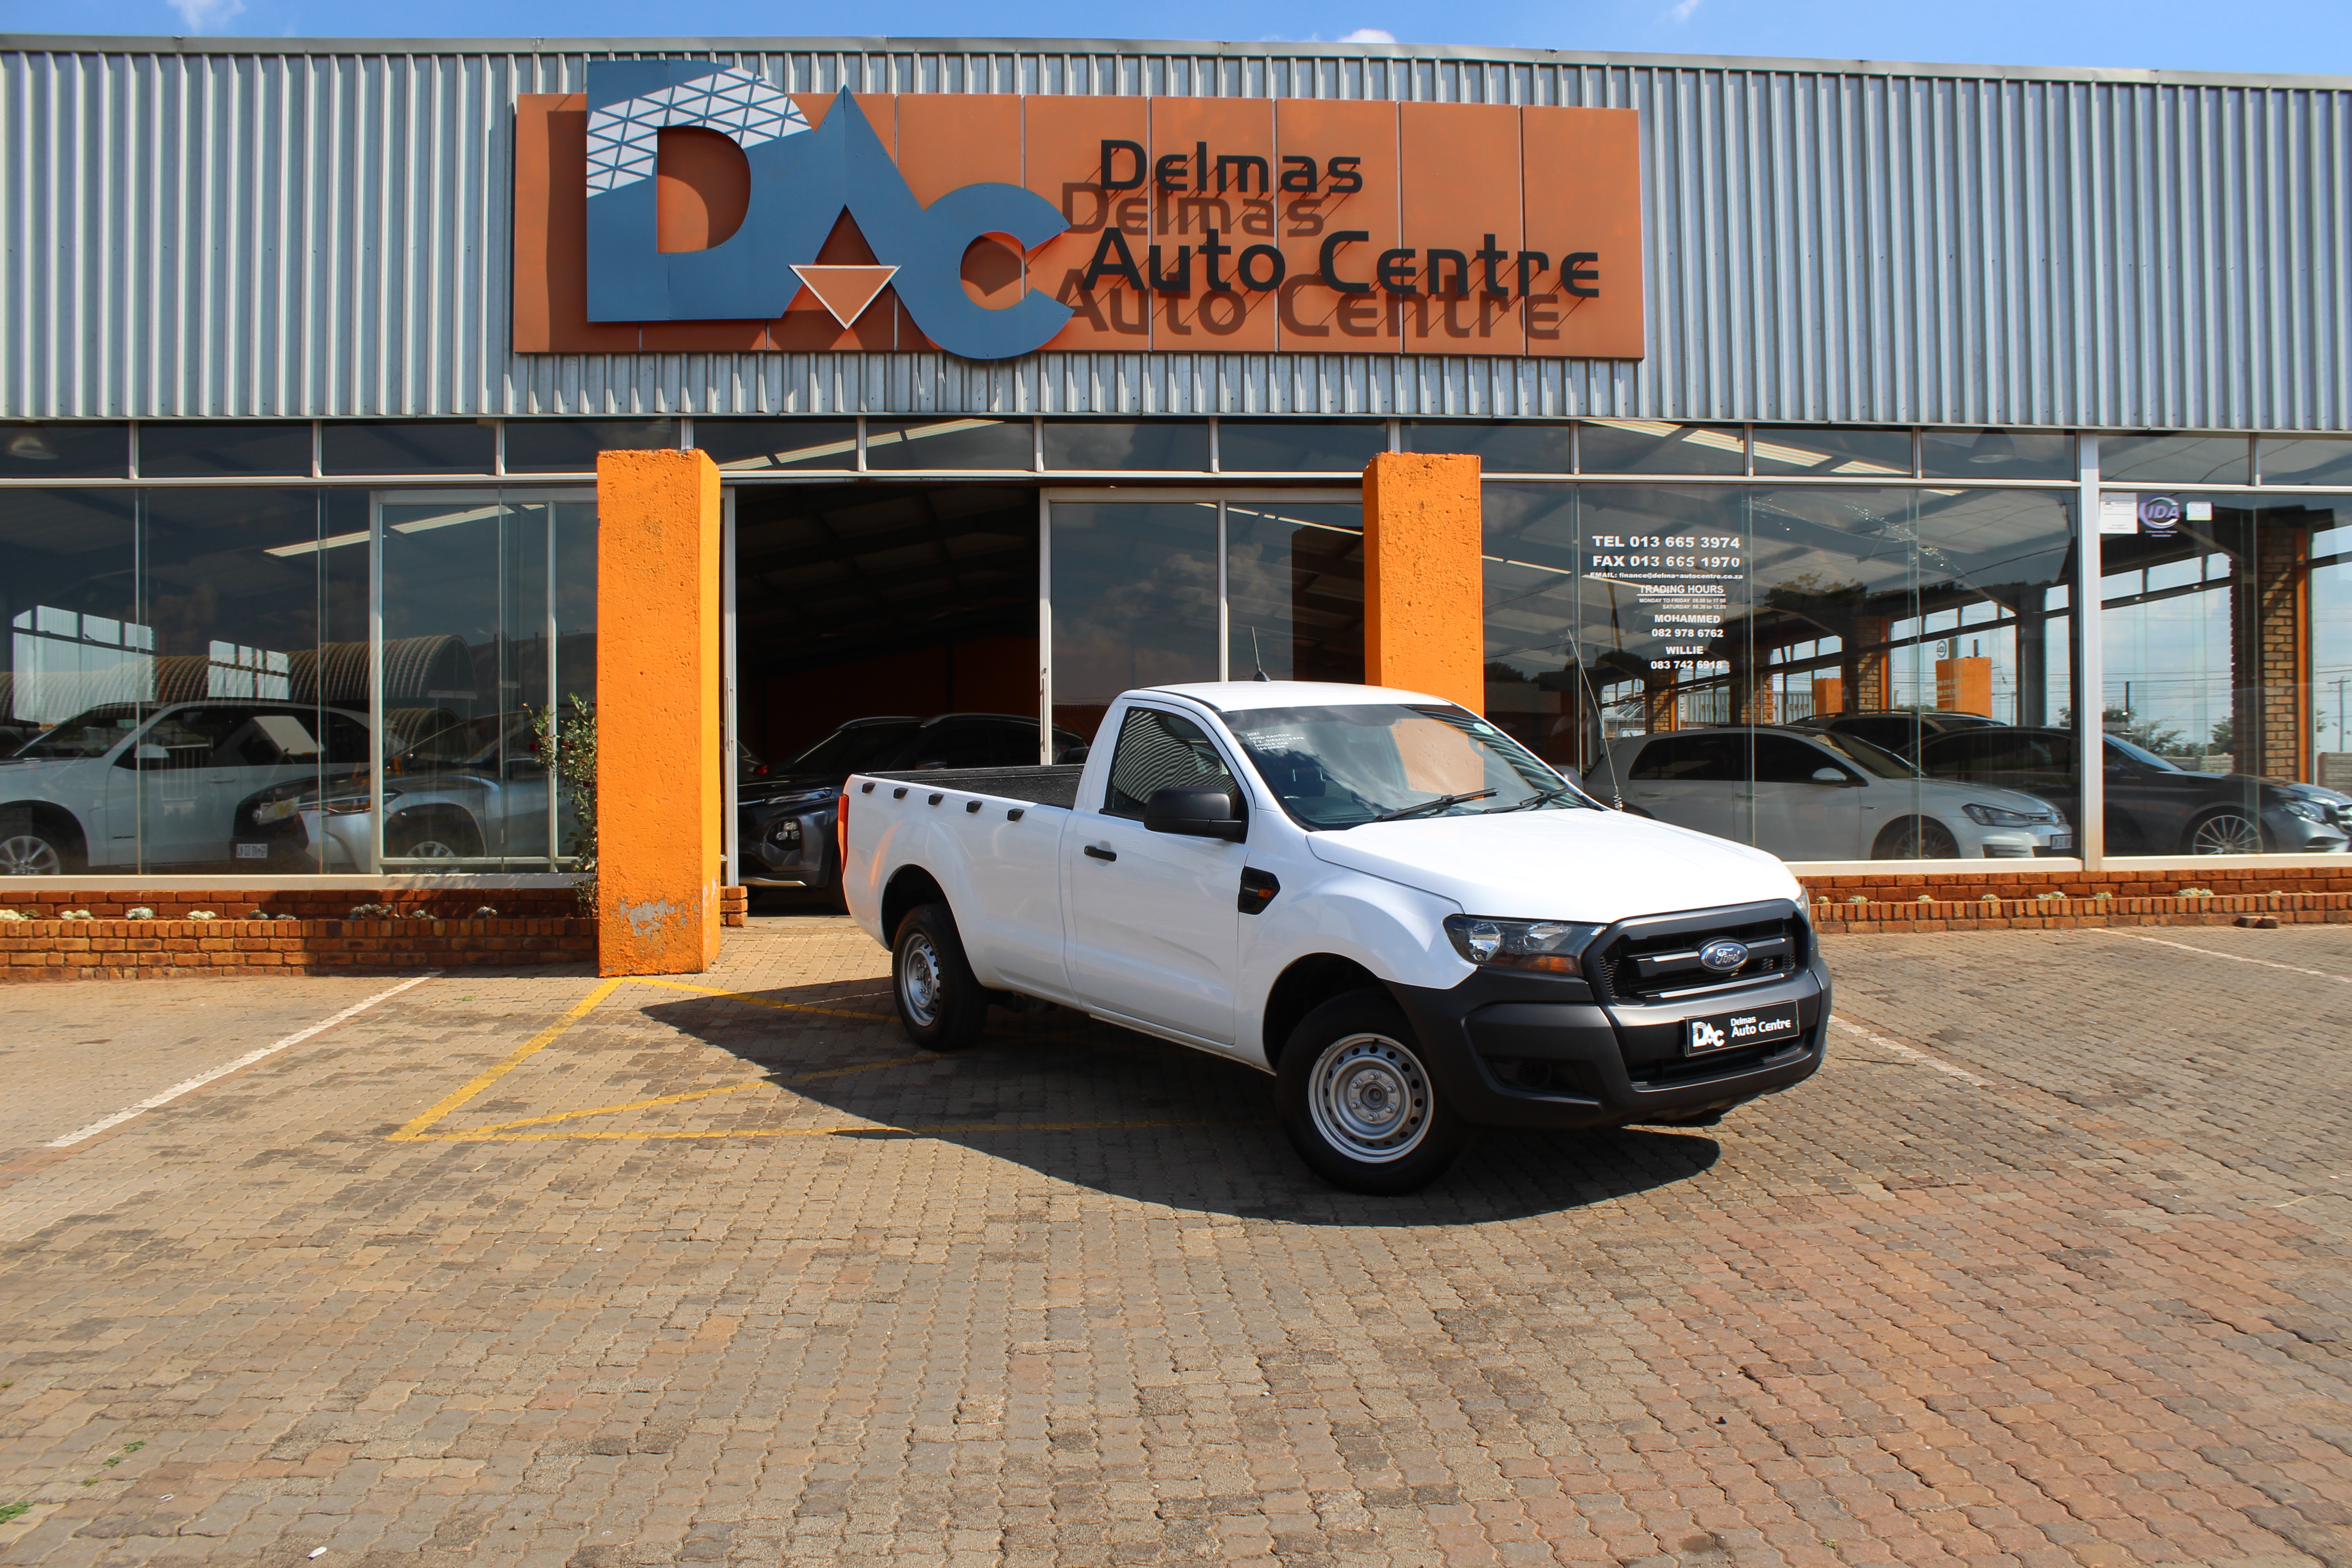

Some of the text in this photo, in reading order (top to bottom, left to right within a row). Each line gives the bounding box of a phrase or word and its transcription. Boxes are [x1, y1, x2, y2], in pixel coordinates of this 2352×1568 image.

[1100, 139, 1362, 194] Delmas
[1082, 227, 1599, 298] Auto Centre
[2148, 505, 2180, 518] IDA
[1592, 535, 1740, 549] TEL 013 665 3974
[1592, 555, 1740, 568] FAX 013 665 1970
[1639, 585, 1724, 593] TRADING HOURS
[1654, 614, 1721, 623] MOHAMMED
[1651, 628, 1724, 637] 082 978 6762
[1666, 646, 1704, 655] WILLIE
[1651, 661, 1723, 669] 083 742 6918
[1715, 947, 1741, 965] Ford
[1730, 1016, 1757, 1027] Delmas
[1731, 1019, 1792, 1038] Auto Centre
